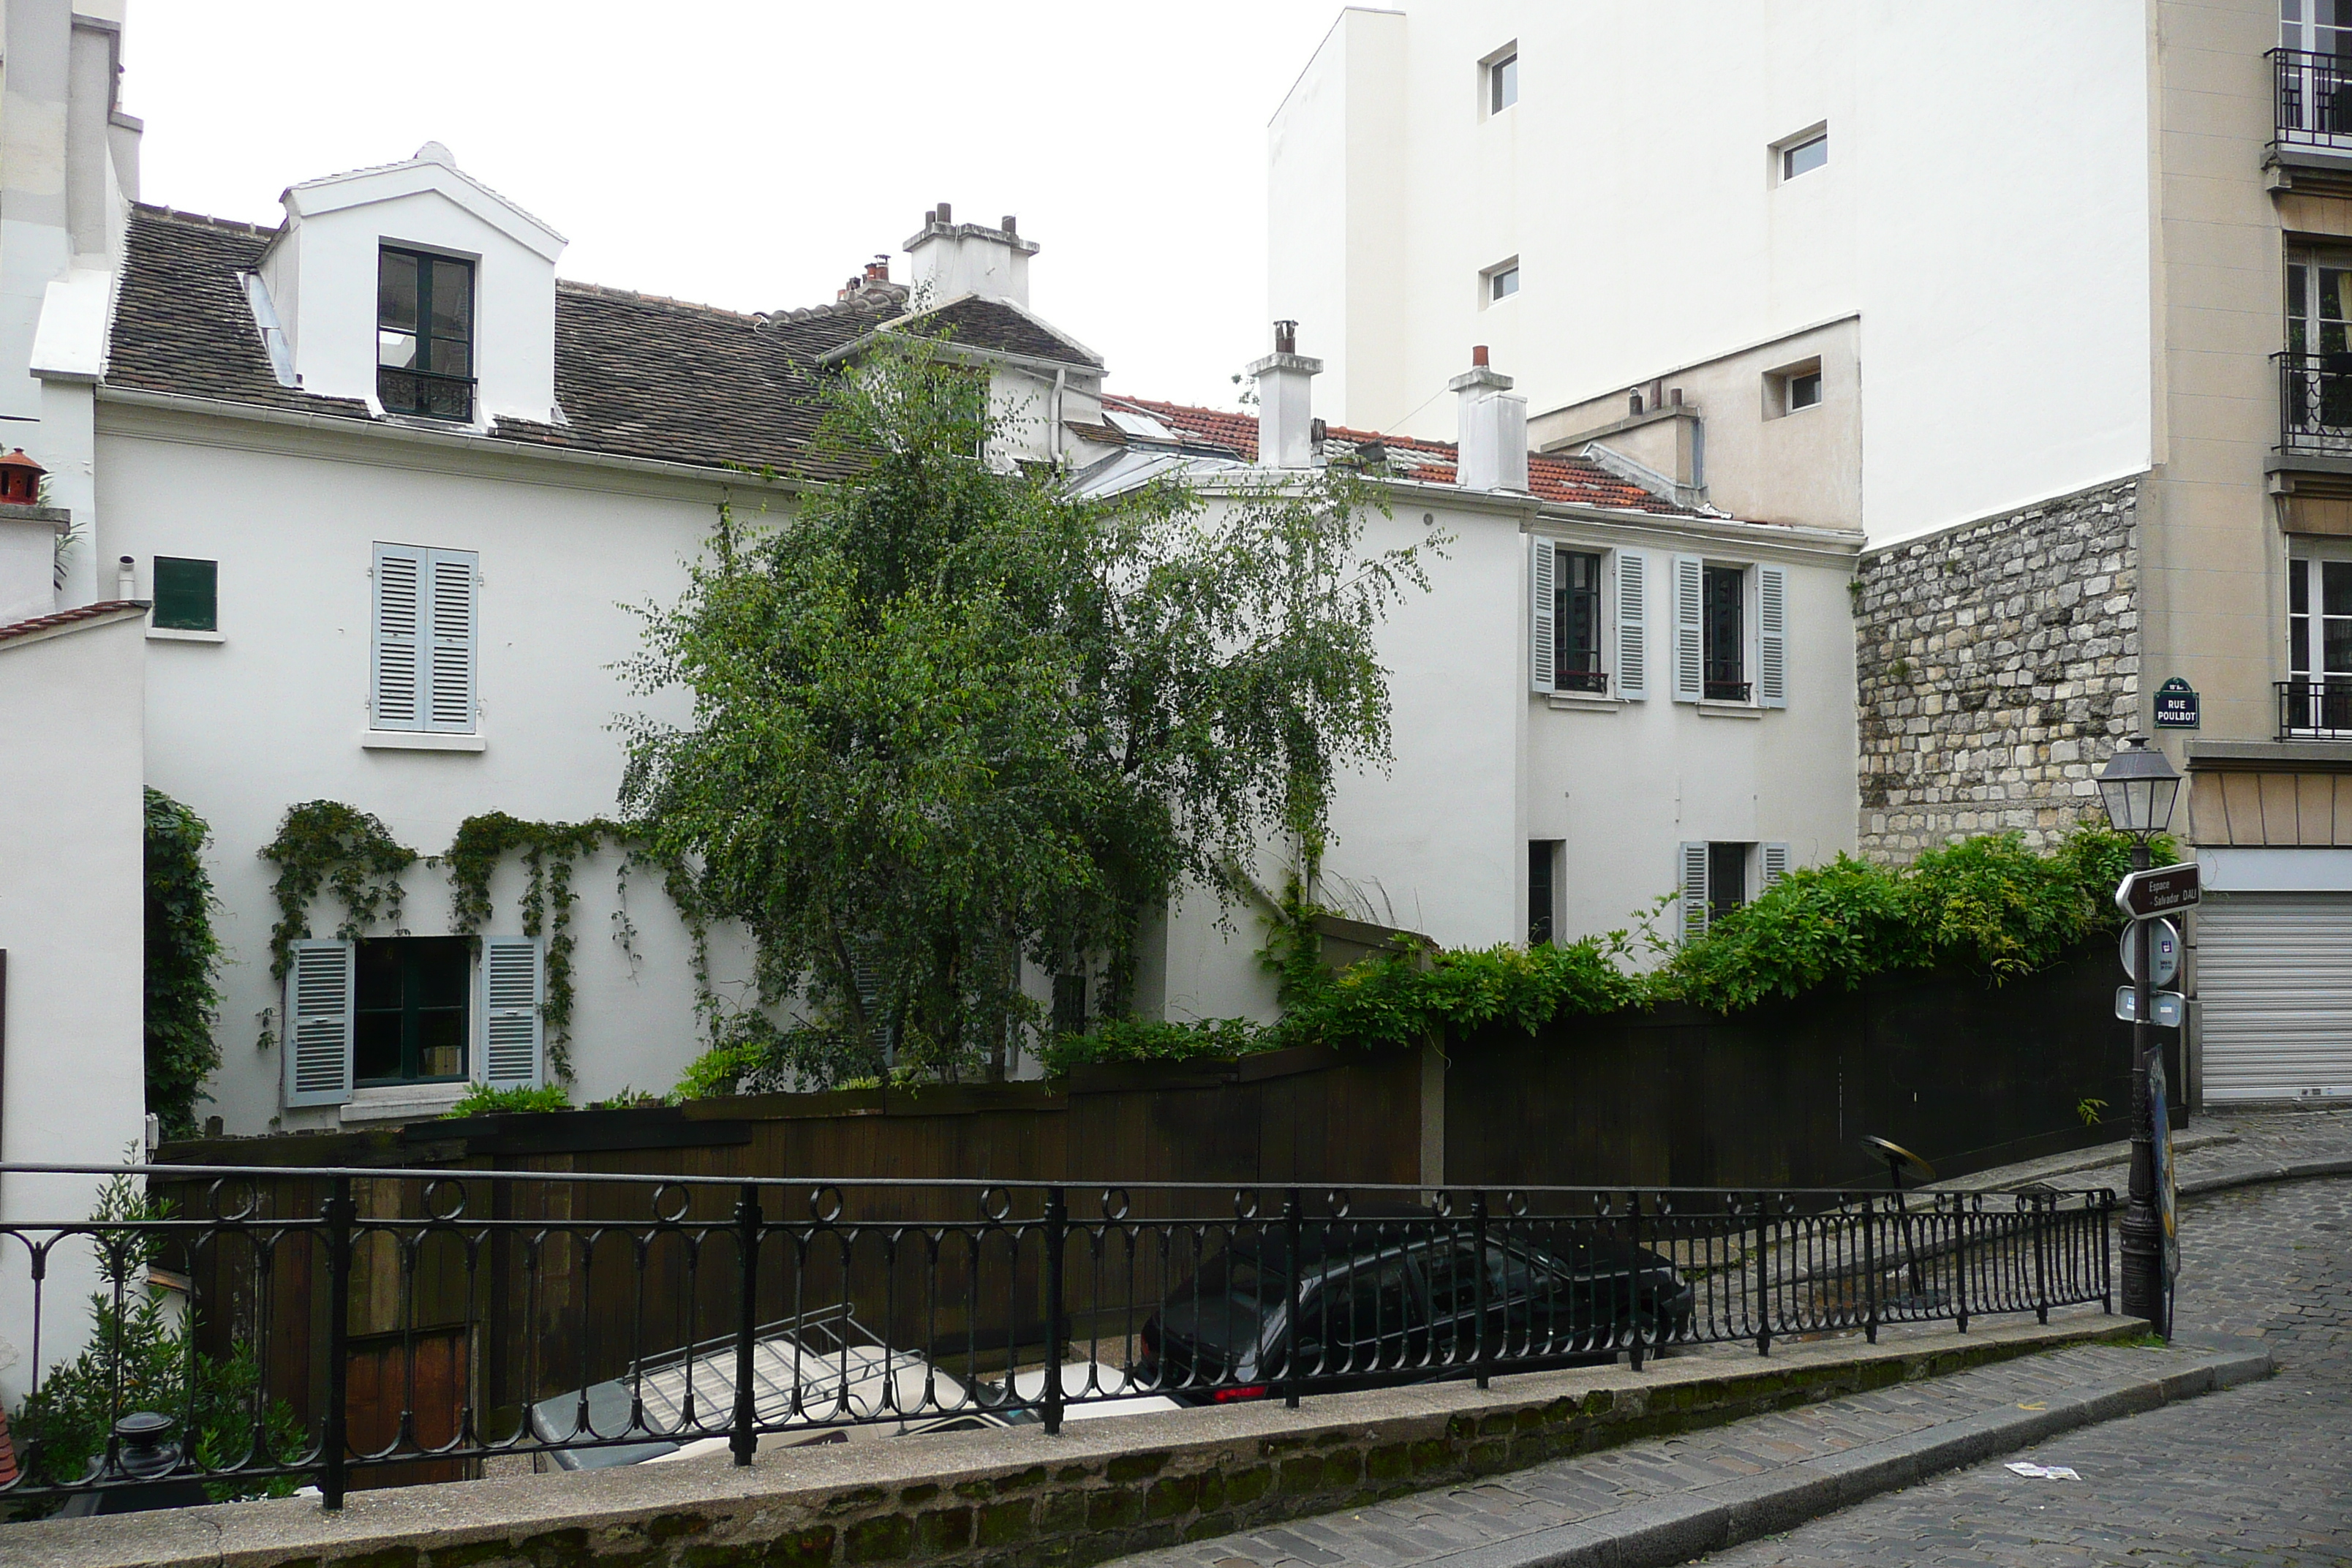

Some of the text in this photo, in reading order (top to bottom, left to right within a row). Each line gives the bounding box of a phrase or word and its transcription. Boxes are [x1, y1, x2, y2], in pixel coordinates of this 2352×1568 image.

[2168, 700, 2186, 709] RUE
[2158, 711, 2196, 721] POULBOT
[2149, 881, 2170, 894] Espace
[2154, 888, 2197, 907] Salvador DALI
